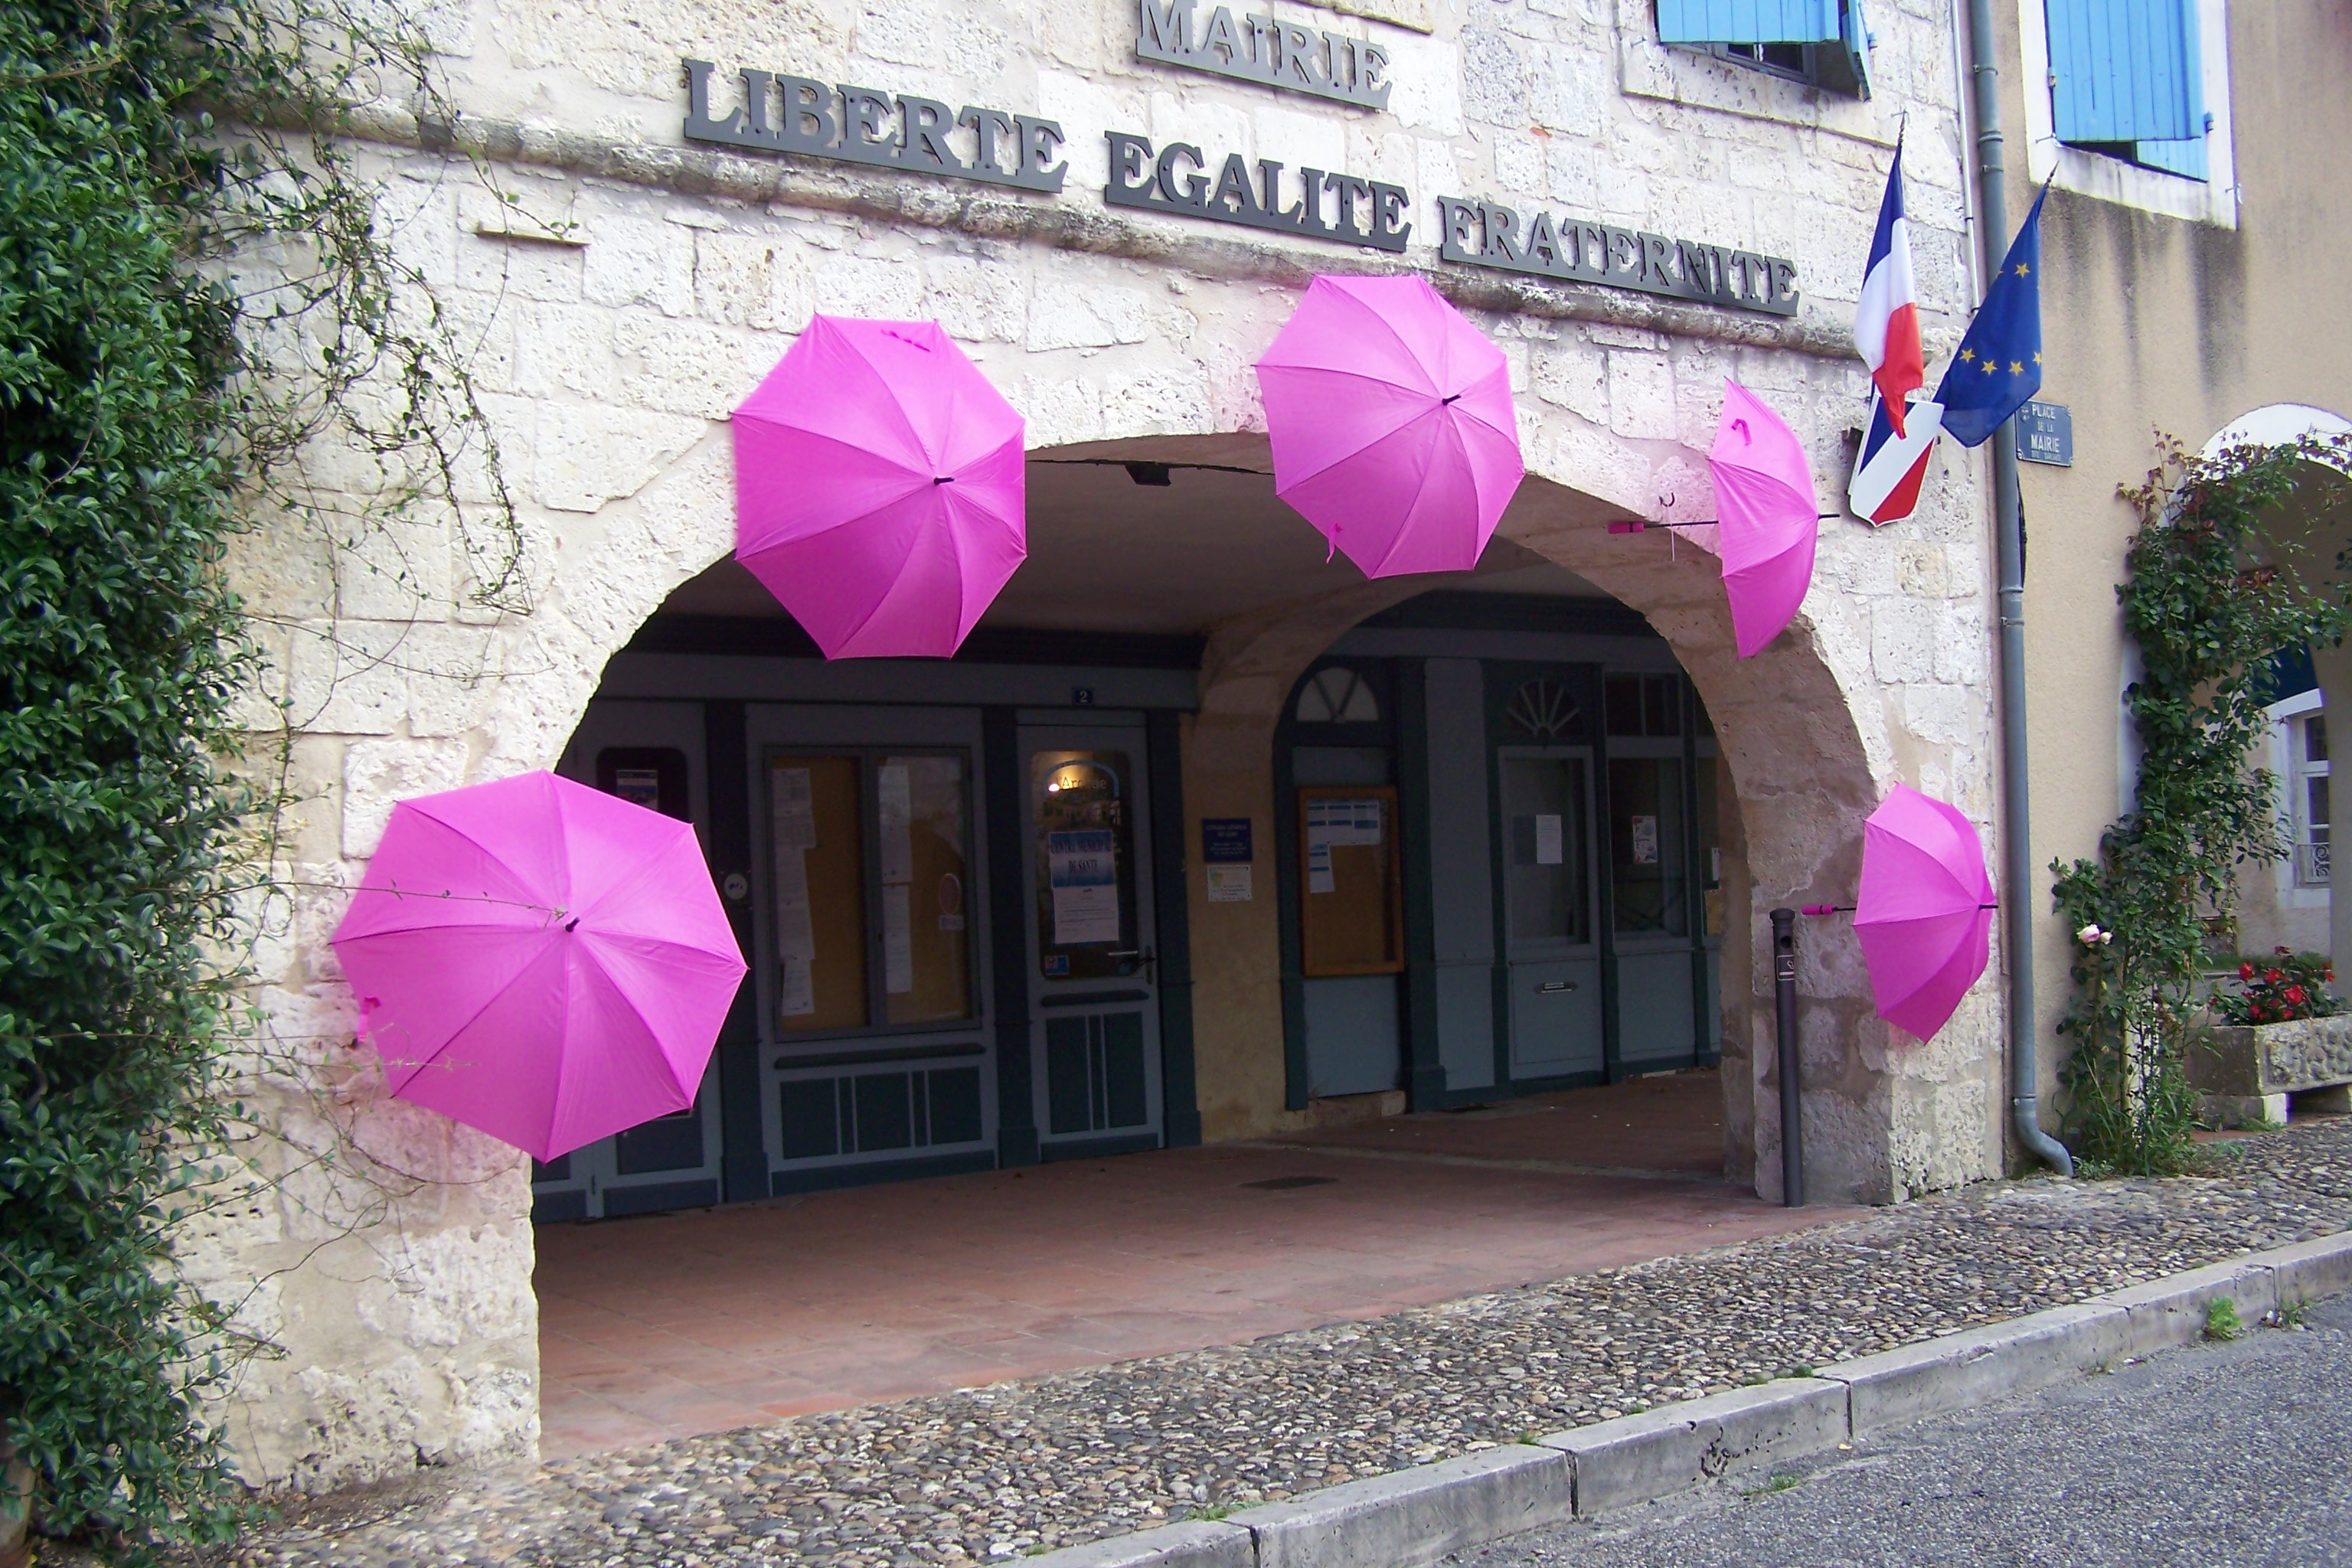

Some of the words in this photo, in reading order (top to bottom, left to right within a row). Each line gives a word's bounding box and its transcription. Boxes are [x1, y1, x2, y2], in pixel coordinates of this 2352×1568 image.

[1136, 0, 1392, 110] MAIRIE
[683, 58, 1068, 194] LIBERTE
[1105, 131, 1413, 253] EGALITE
[1438, 196, 1799, 317] FRATERNITE
[2032, 403, 2056, 420] PLACE
[2037, 421, 2044, 432] DE
[2047, 423, 2053, 433] LA
[2030, 433, 2060, 453] MAIRIE
[1080, 691, 1088, 703] 2
[1068, 860, 1076, 871] DE
